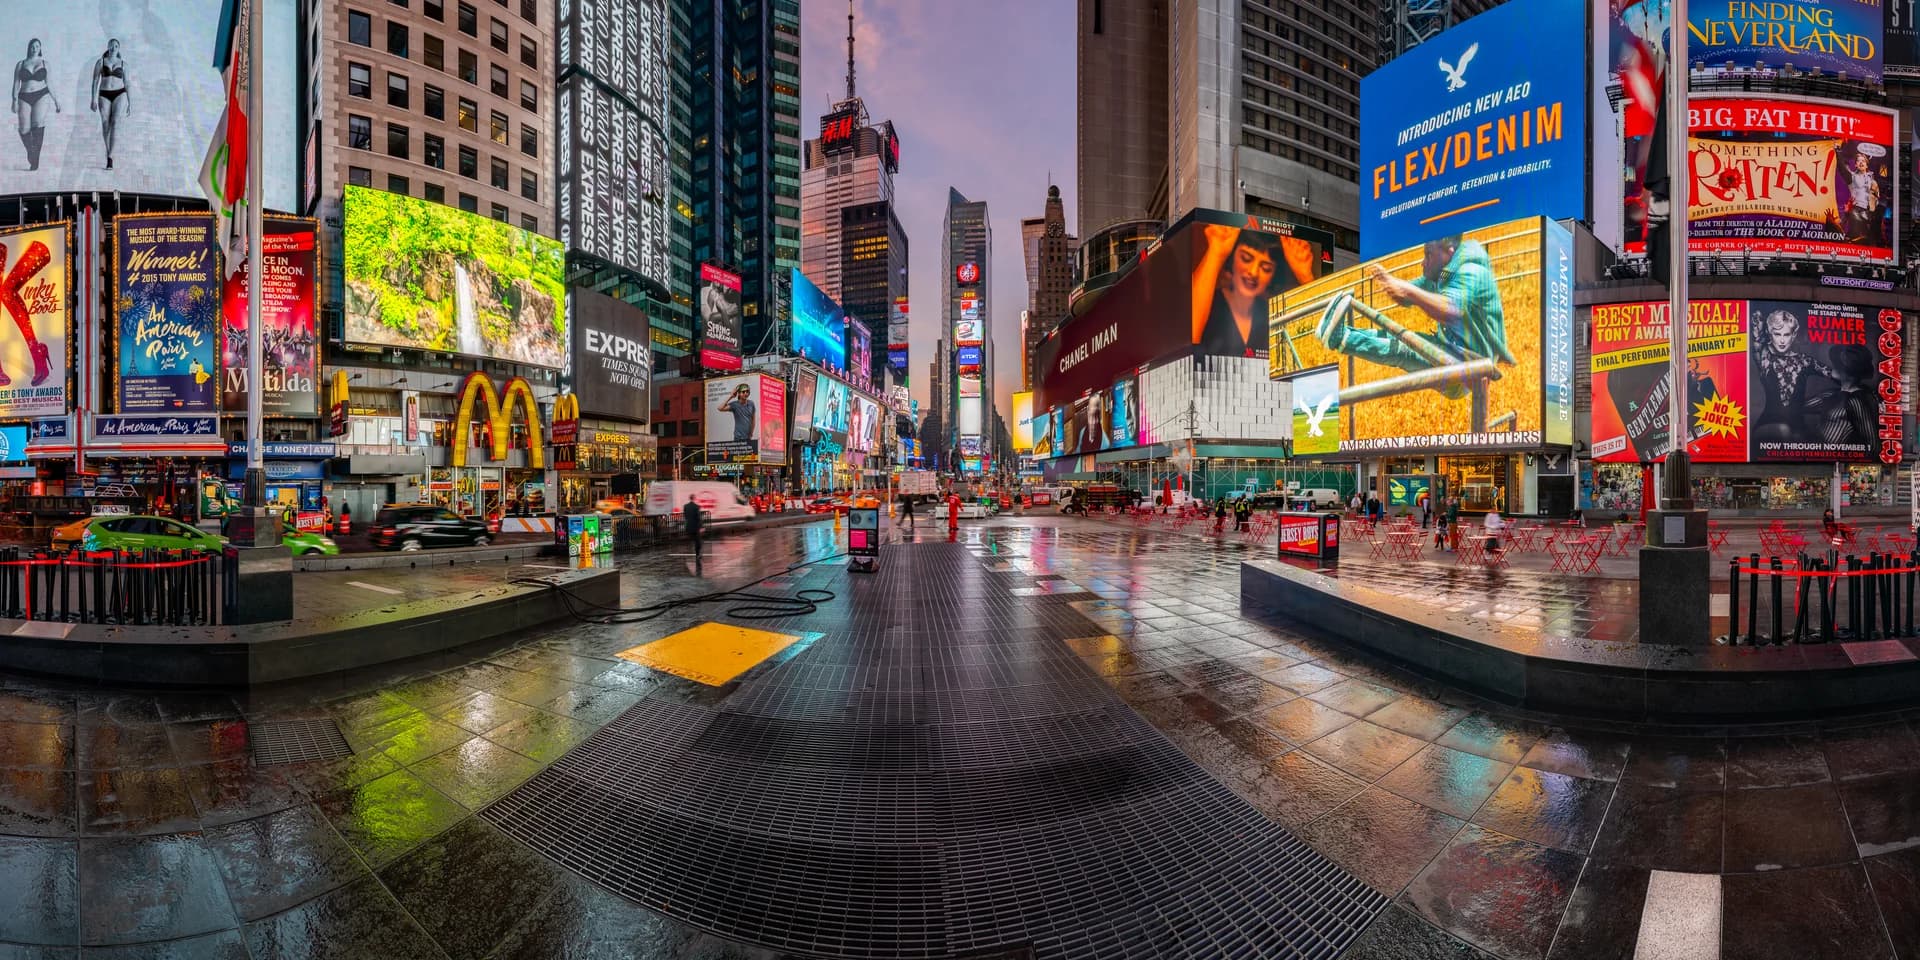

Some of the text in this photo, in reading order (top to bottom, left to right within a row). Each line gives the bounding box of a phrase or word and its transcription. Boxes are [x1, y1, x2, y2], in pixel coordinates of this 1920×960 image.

[1728, 2, 1833, 28] FINDING
[1688, 19, 1875, 61] NEVERLAND
[641, 2, 651, 98] EXPRESS
[1398, 81, 1531, 147] INTRODUCING NEW AEO
[1745, 109, 1790, 128] FAT
[561, 90, 570, 176] EXPRESS
[1373, 101, 1563, 200] FLEX/DENIM
[1698, 142, 1818, 157] SOMETHING
[1381, 159, 1552, 219] REVOLUTIONARY COMFORT, RETENTION & DURABILITY.
[582, 150, 594, 253] EXPRESS
[1692, 205, 1734, 218] BROADWAY'S
[140, 228, 156, 236] MOST
[157, 227, 207, 235] AWARD-WINNING
[1263, 219, 1296, 230] MARRIOTT
[1263, 226, 1293, 236] MARQUIS
[1764, 219, 1809, 230] ALADDIN
[1810, 223, 1823, 231] AND
[130, 236, 156, 244] MUSICAL
[627, 212, 638, 267] OPEN
[1734, 229, 1754, 237] THE
[1757, 229, 1785, 238] BOOK
[1787, 230, 1800, 238] OF
[1802, 231, 1846, 241] MORMON
[127, 246, 208, 272] Winner!
[278, 257, 289, 266] IN
[128, 272, 207, 287] 4 2015 TONY AWARDS
[271, 266, 305, 277] MOON,
[28, 299, 64, 315] Boots
[1560, 247, 1569, 354] AMERICAN
[1842, 304, 1858, 312] WITH
[148, 302, 166, 325] An
[1597, 306, 1644, 328] BEST
[1808, 316, 1865, 332] RUMER
[135, 319, 204, 347] American
[1551, 281, 1559, 385] OUTFITTERS
[1597, 327, 1632, 343] TONY
[1635, 325, 1670, 340] AWAR
[1808, 330, 1866, 346] WILLIS
[146, 340, 190, 361] Paris
[1060, 322, 1118, 374] CHANEL IMAN
[1596, 355, 1620, 368] FINAL
[1688, 339, 1726, 354] JANUARY
[602, 357, 628, 372] TIMES
[224, 366, 313, 393] Mtilda
[610, 373, 646, 390] NOW OPEN
[1878, 309, 1903, 464] CHICAGO
[18, 389, 34, 398] TONY
[36, 387, 63, 397] AWARDS
[1629, 400, 1639, 412] A
[1713, 402, 1729, 415] NO
[117, 418, 163, 435] American
[1702, 410, 1734, 428] JOKE!
[595, 432, 630, 444] EXPRESS
[1340, 432, 1541, 450] AMERICAN EAGLE OUTFITTERS
[1593, 443, 1608, 455] THIS
[1608, 441, 1615, 452] IS
[1760, 442, 1872, 452] NOW THROUGH NOVEMBER 1
[1281, 527, 1303, 543] JERSEY
